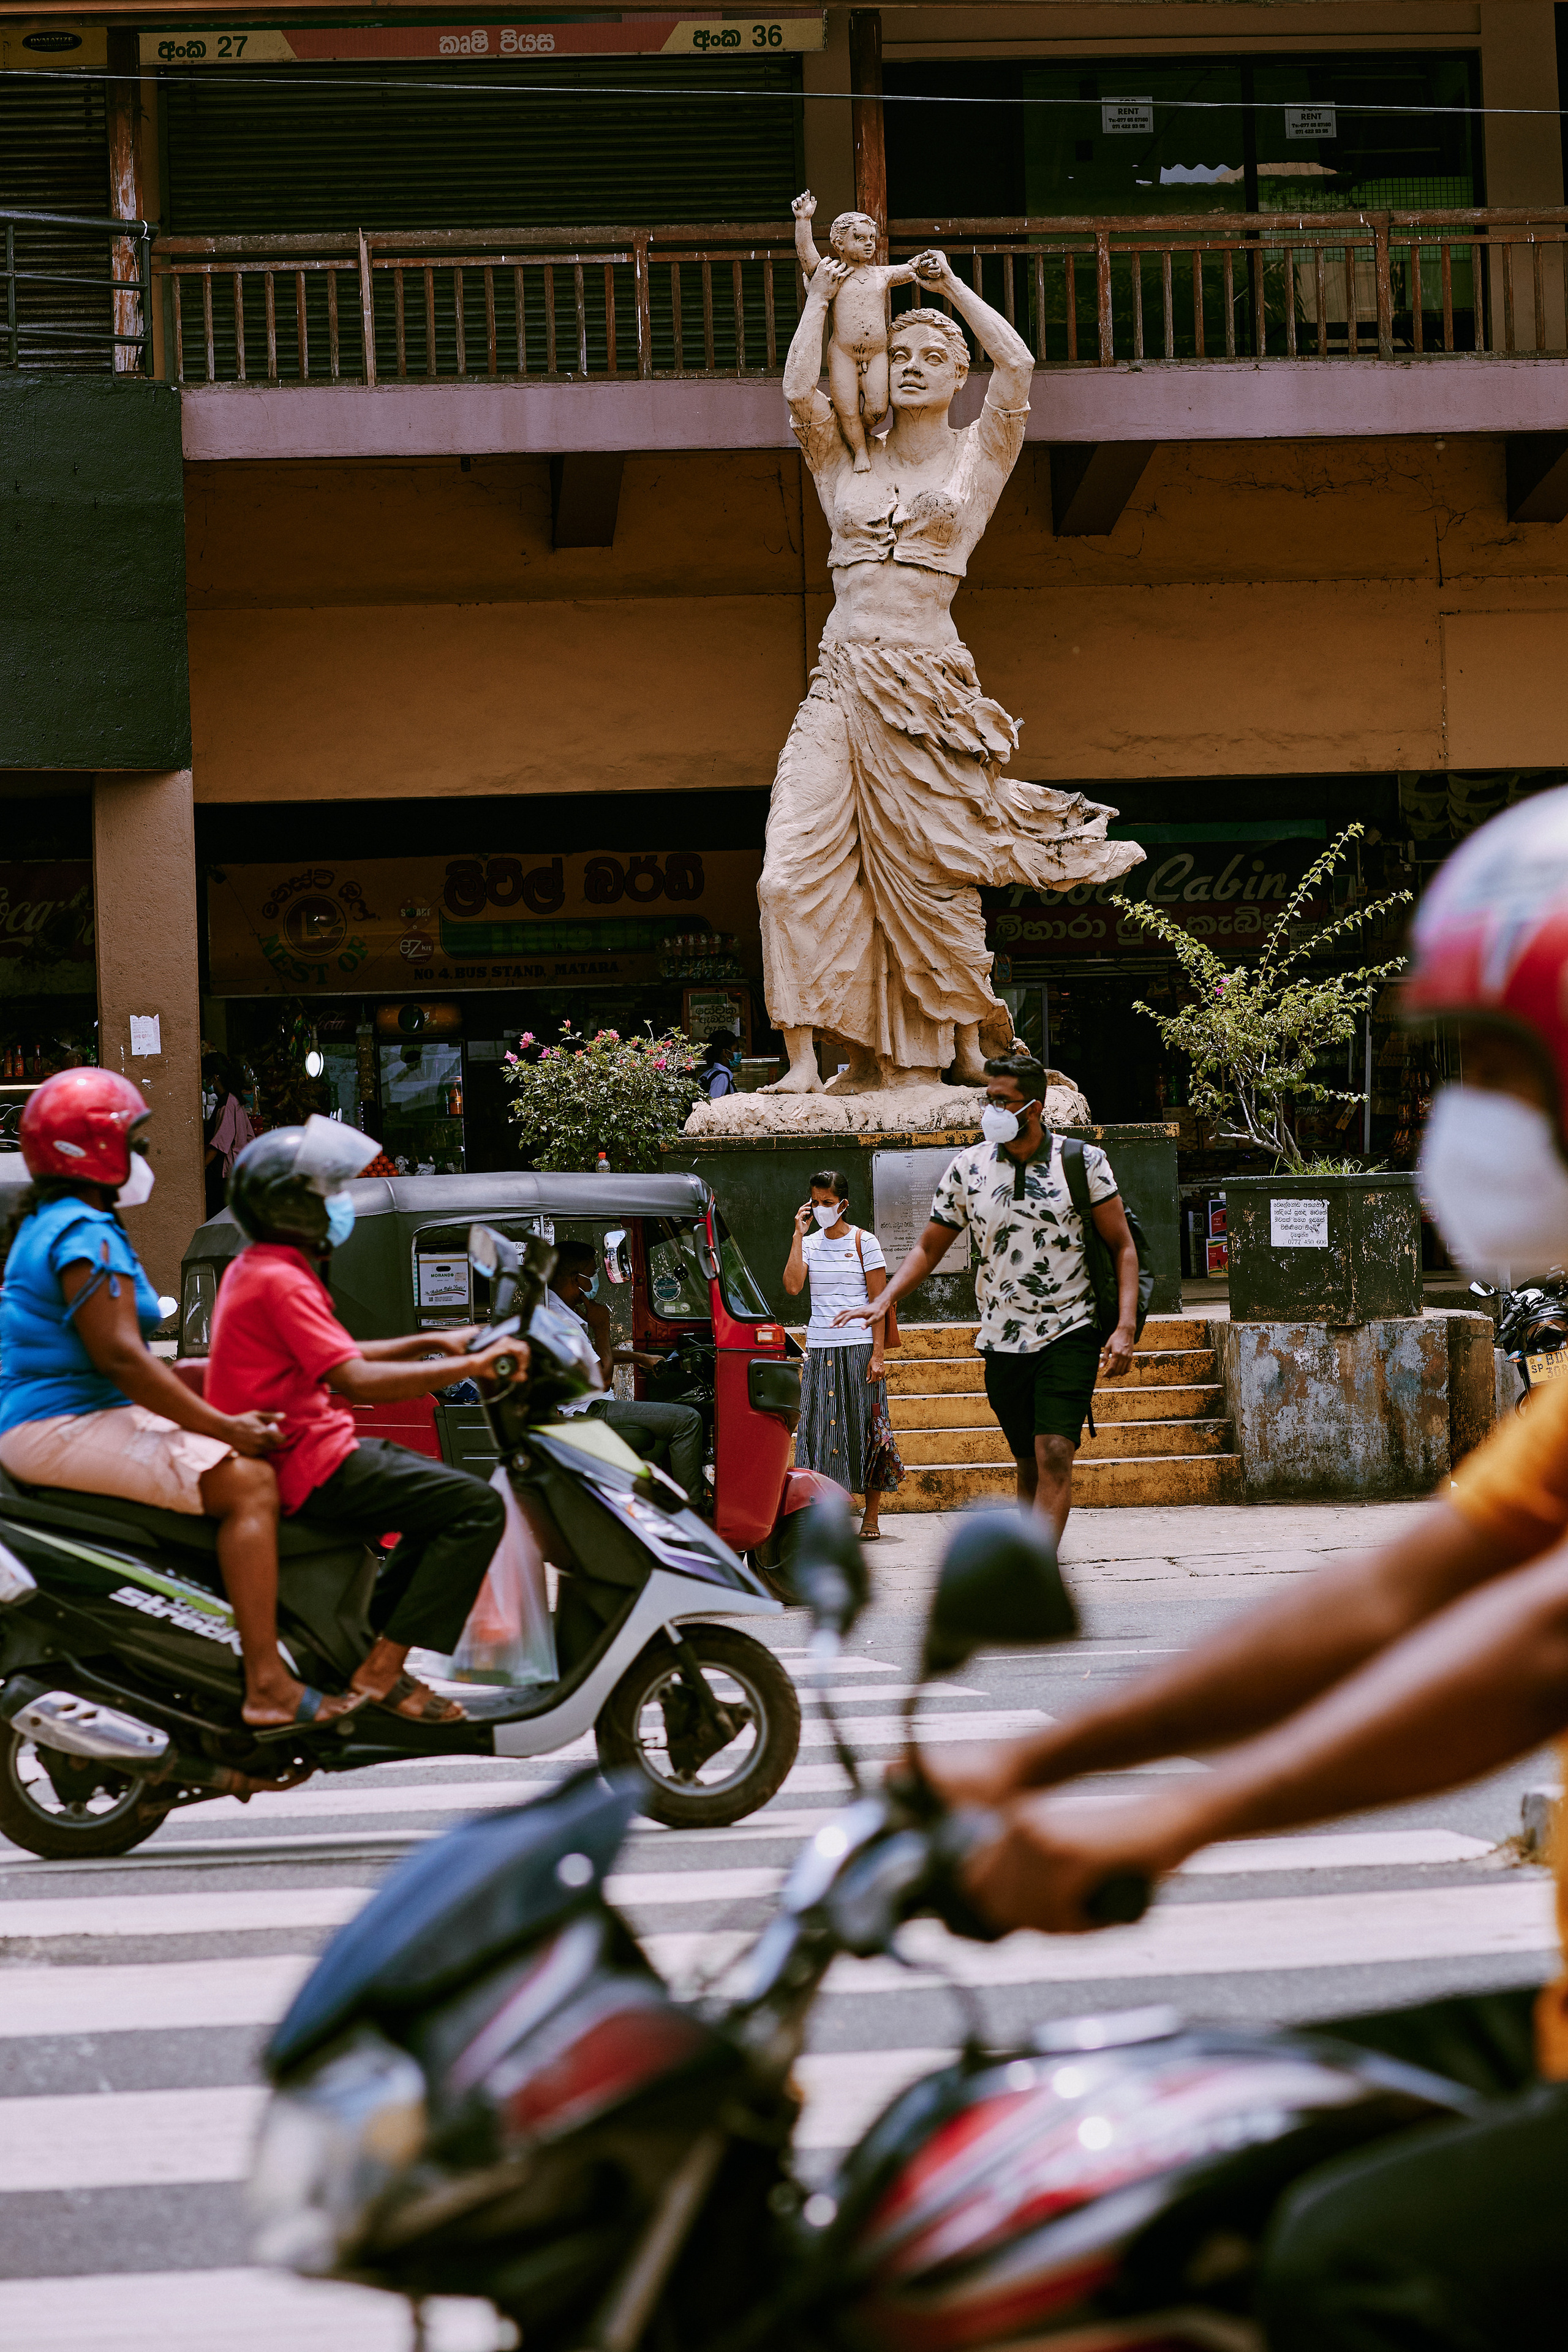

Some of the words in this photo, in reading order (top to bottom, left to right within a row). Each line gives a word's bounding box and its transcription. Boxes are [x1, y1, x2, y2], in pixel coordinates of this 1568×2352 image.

[158, 39, 206, 61] අංක
[217, 36, 248, 58] 27
[439, 29, 489, 53] කෘෂි
[500, 29, 555, 53] පියස
[693, 29, 741, 51] අංක
[752, 25, 783, 47] 36
[1147, 853, 1287, 902] Cabin
[258, 934, 329, 985] NEST
[337, 936, 368, 973] OF
[415, 968, 434, 979] NO
[1531, 1363, 1544, 1373] SP
[108, 1586, 244, 1656] Streak
